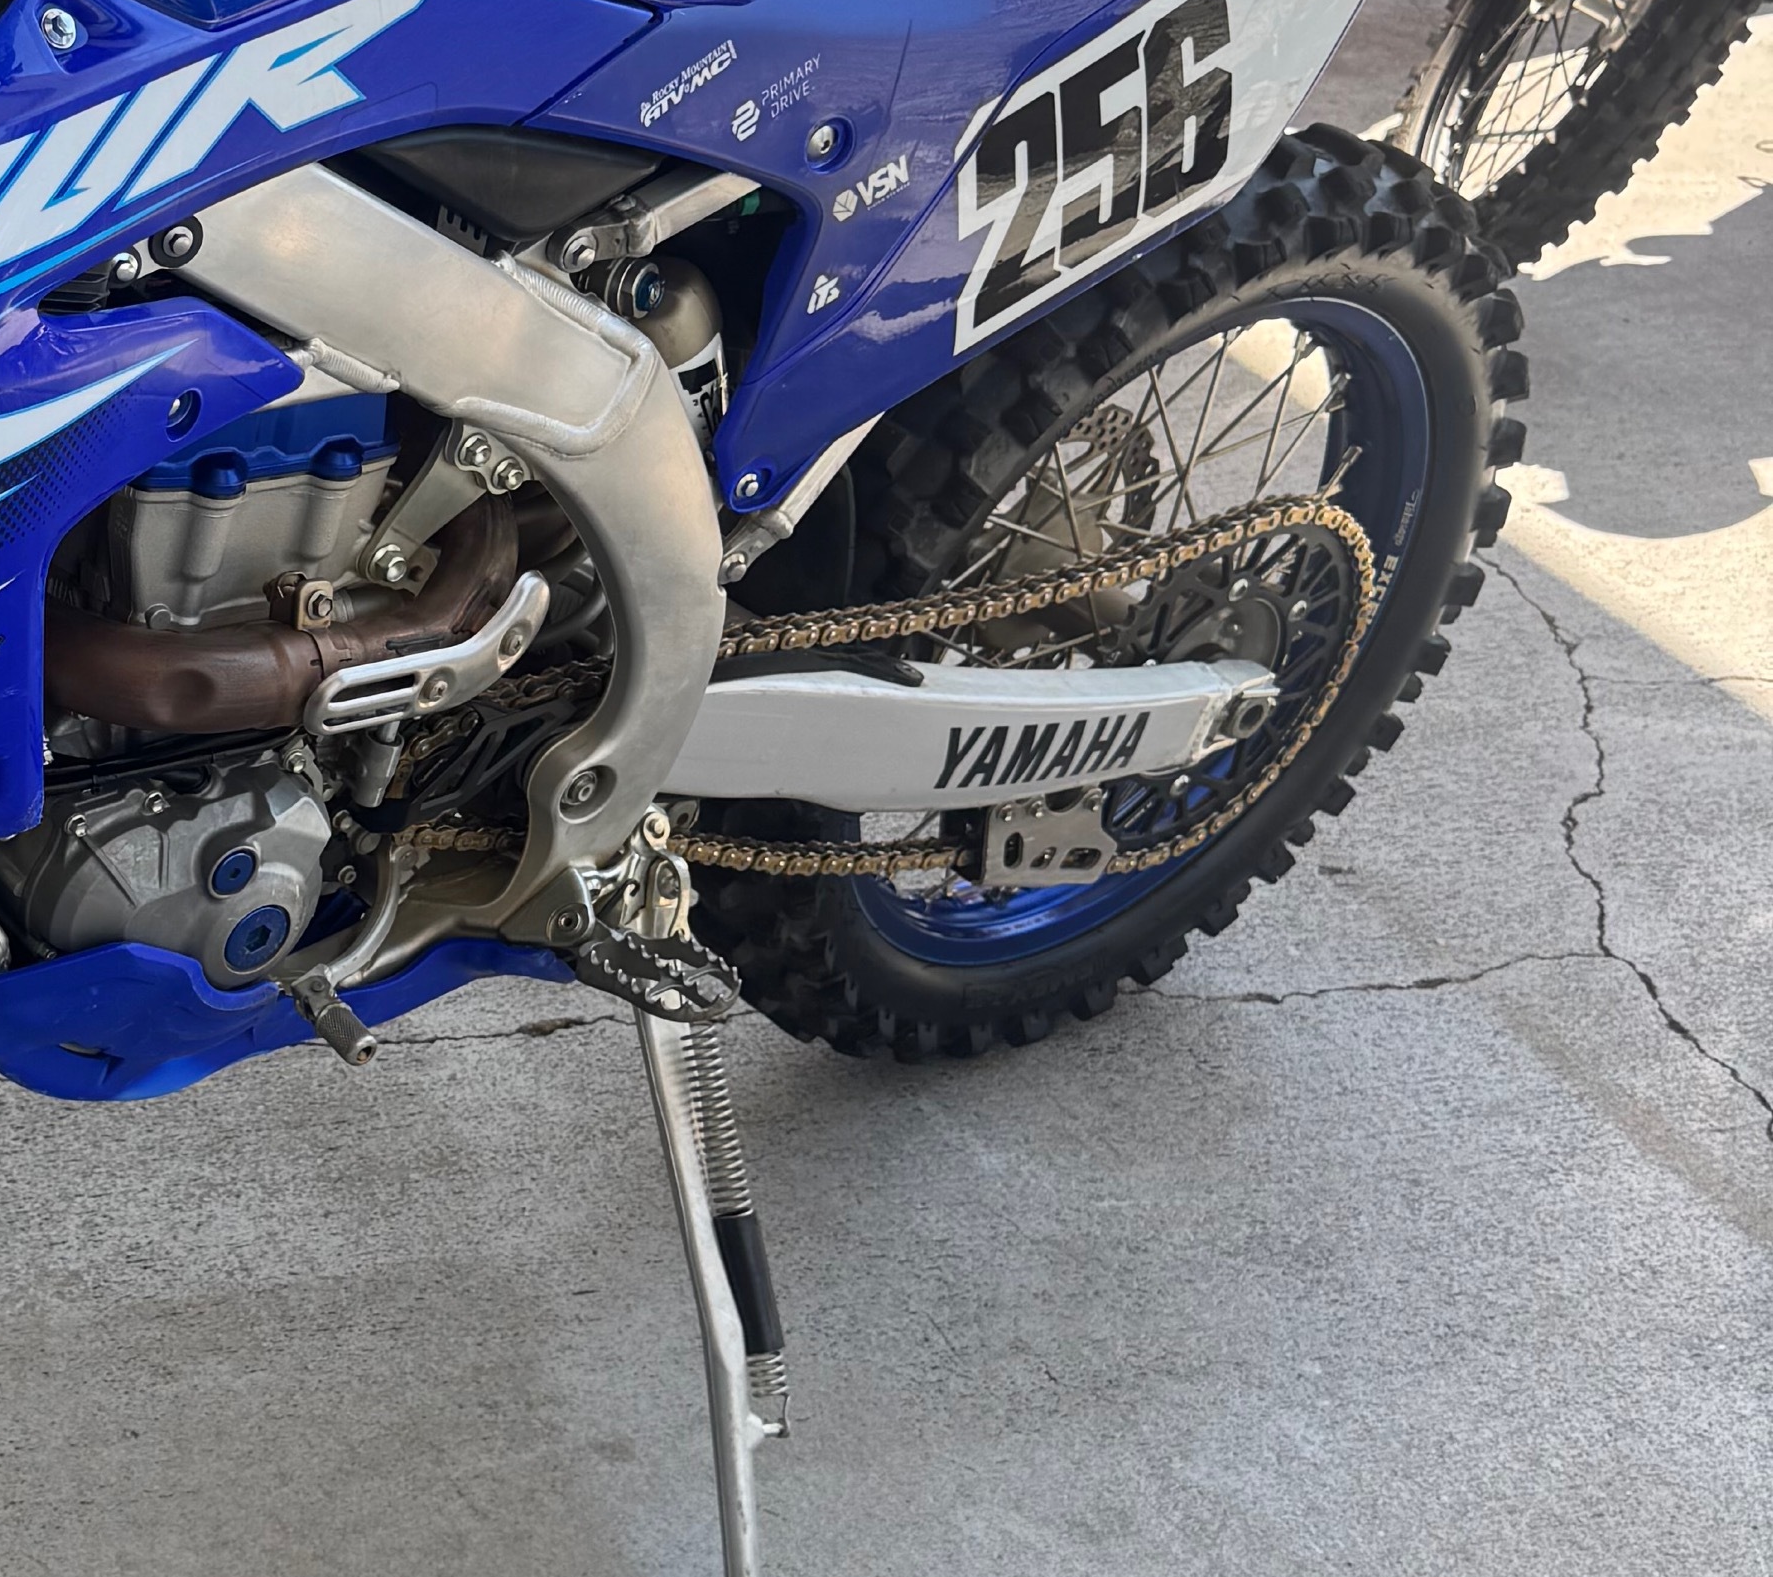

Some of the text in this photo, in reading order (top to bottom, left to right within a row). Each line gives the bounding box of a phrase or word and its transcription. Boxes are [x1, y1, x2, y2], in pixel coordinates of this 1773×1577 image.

[680, 40, 728, 81] MOUNTAIN
[761, 53, 822, 106] PRIMARY
[856, 154, 910, 207] VSN
[933, 711, 1151, 789] YAMAHA
